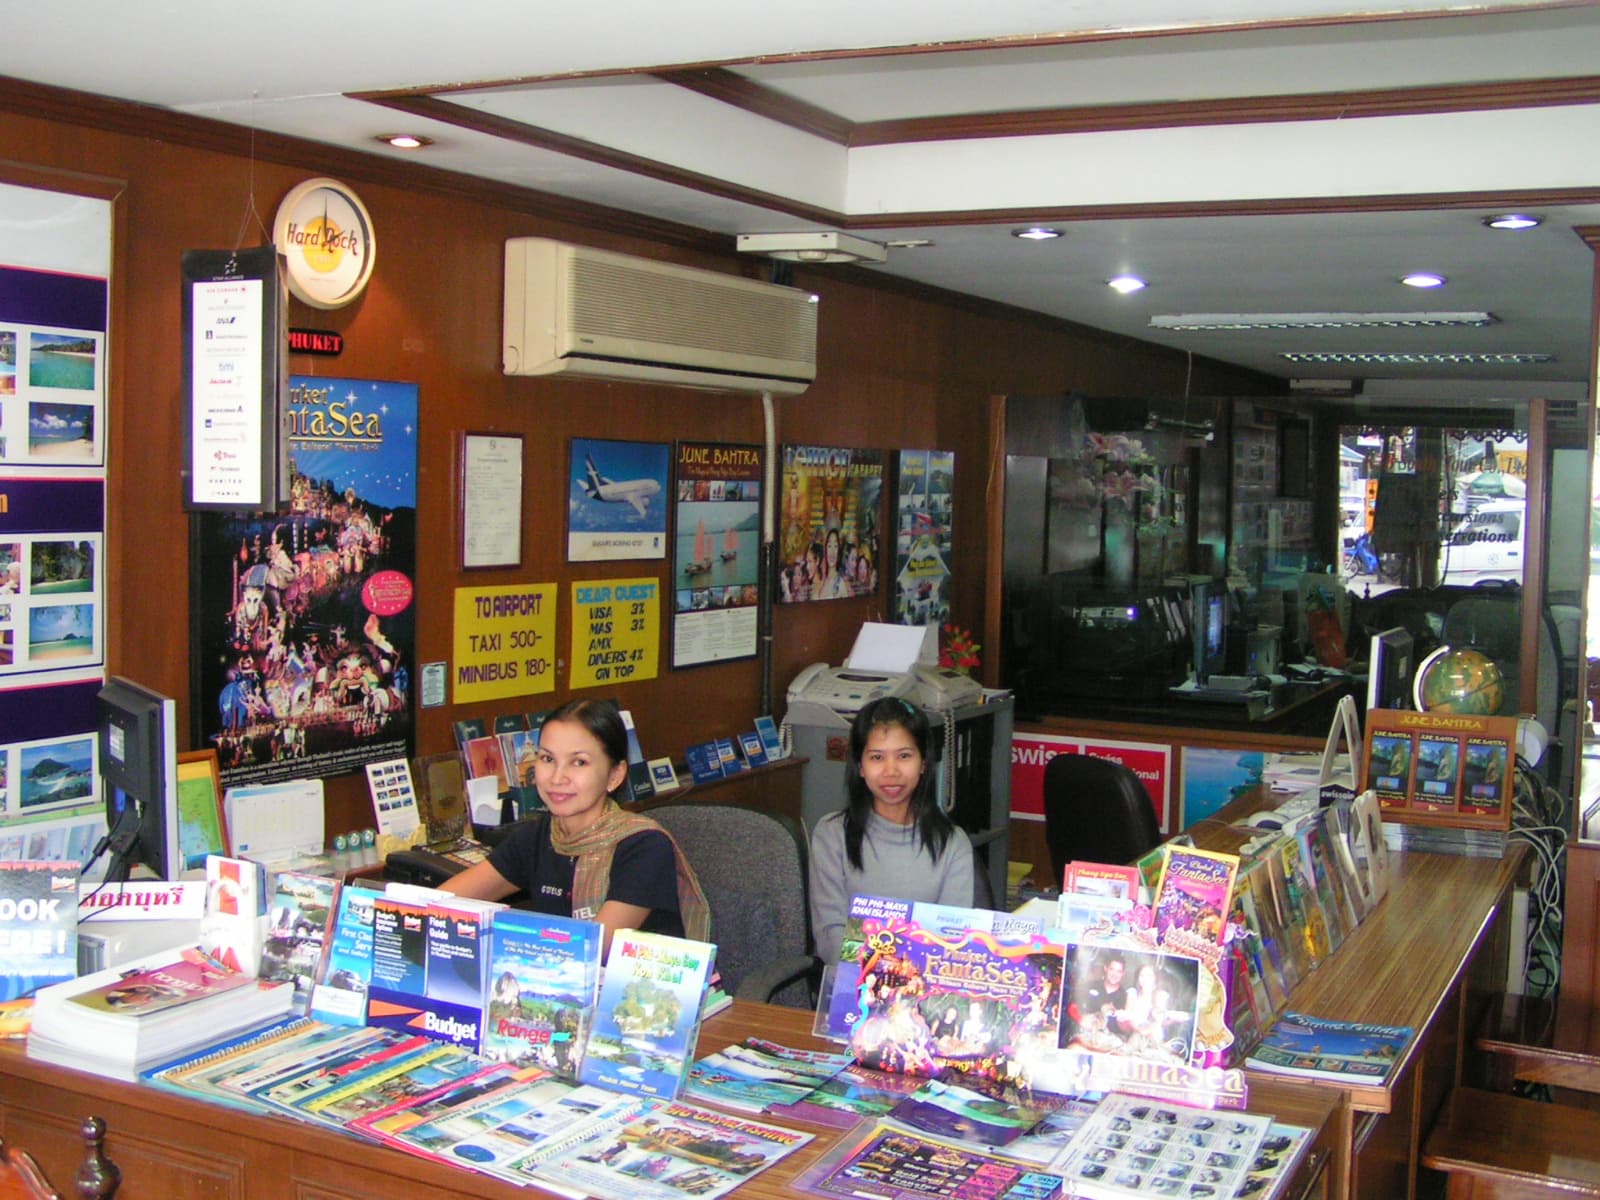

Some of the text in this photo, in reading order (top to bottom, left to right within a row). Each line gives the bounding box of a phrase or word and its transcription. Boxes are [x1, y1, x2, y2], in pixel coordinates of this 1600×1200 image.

[287, 222, 358, 256] Hard Rock
[288, 402, 384, 438] ntaSea
[680, 446, 759, 464] JUNE BAHTRA
[1440, 529, 1515, 544] ervations
[576, 584, 656, 604] DEAR GUEST
[475, 594, 542, 618] TO AIRPORT
[590, 603, 645, 619] VISA 3%
[631, 619, 645, 631] 3%
[469, 634, 502, 653] TAXI
[588, 648, 644, 666] DINERS 4%
[458, 661, 518, 685] MINIBUS
[614, 665, 635, 678] TOP
[853, 897, 908, 912] PHI PHI-MAYA
[924, 952, 1028, 987] FantaSea
[424, 1011, 477, 1042] Budget
[496, 1017, 551, 1045] Range
[694, 1111, 740, 1129] GAME
[739, 1123, 803, 1146] FISHING
